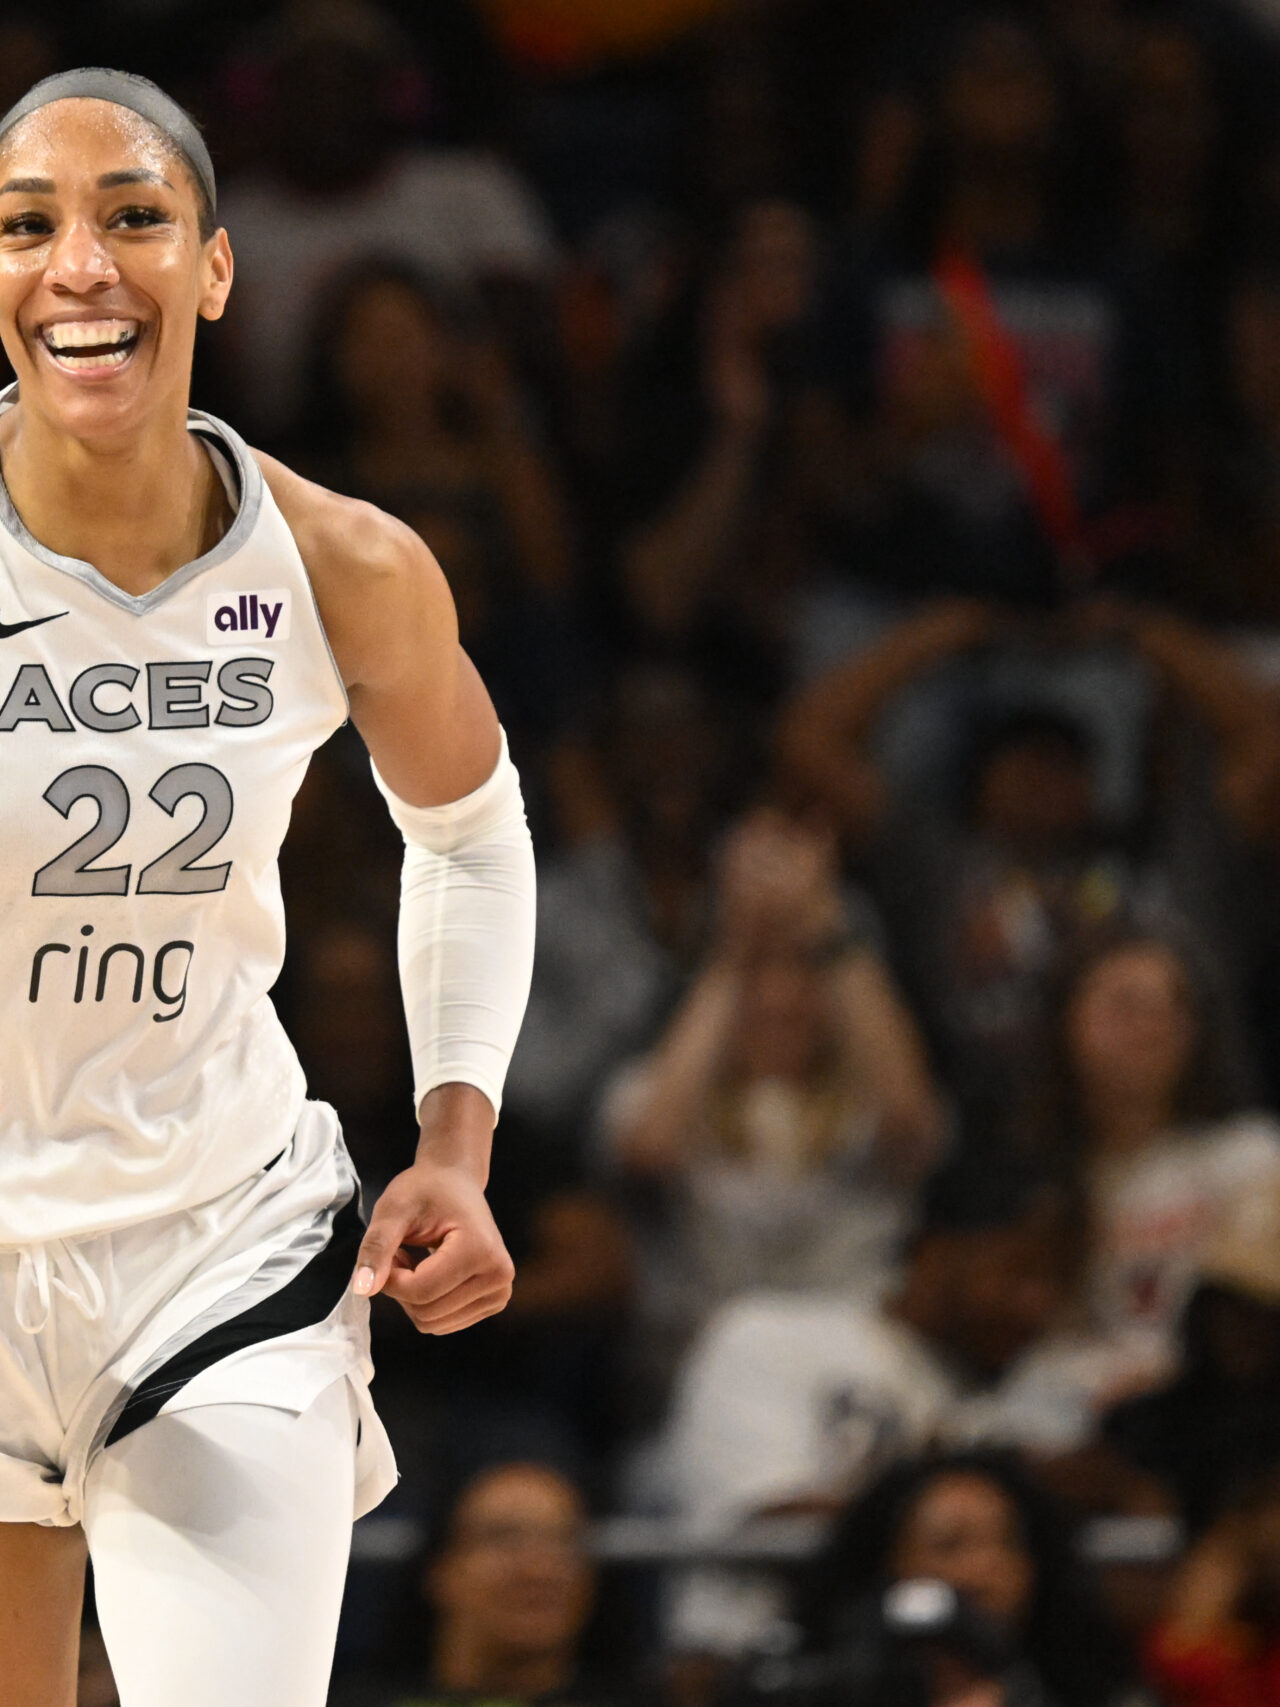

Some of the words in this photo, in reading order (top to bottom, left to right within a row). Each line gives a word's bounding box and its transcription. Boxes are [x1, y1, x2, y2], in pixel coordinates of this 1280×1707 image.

[214, 594, 283, 638] ally
[31, 762, 234, 896] 22
[28, 924, 194, 1023] ring
